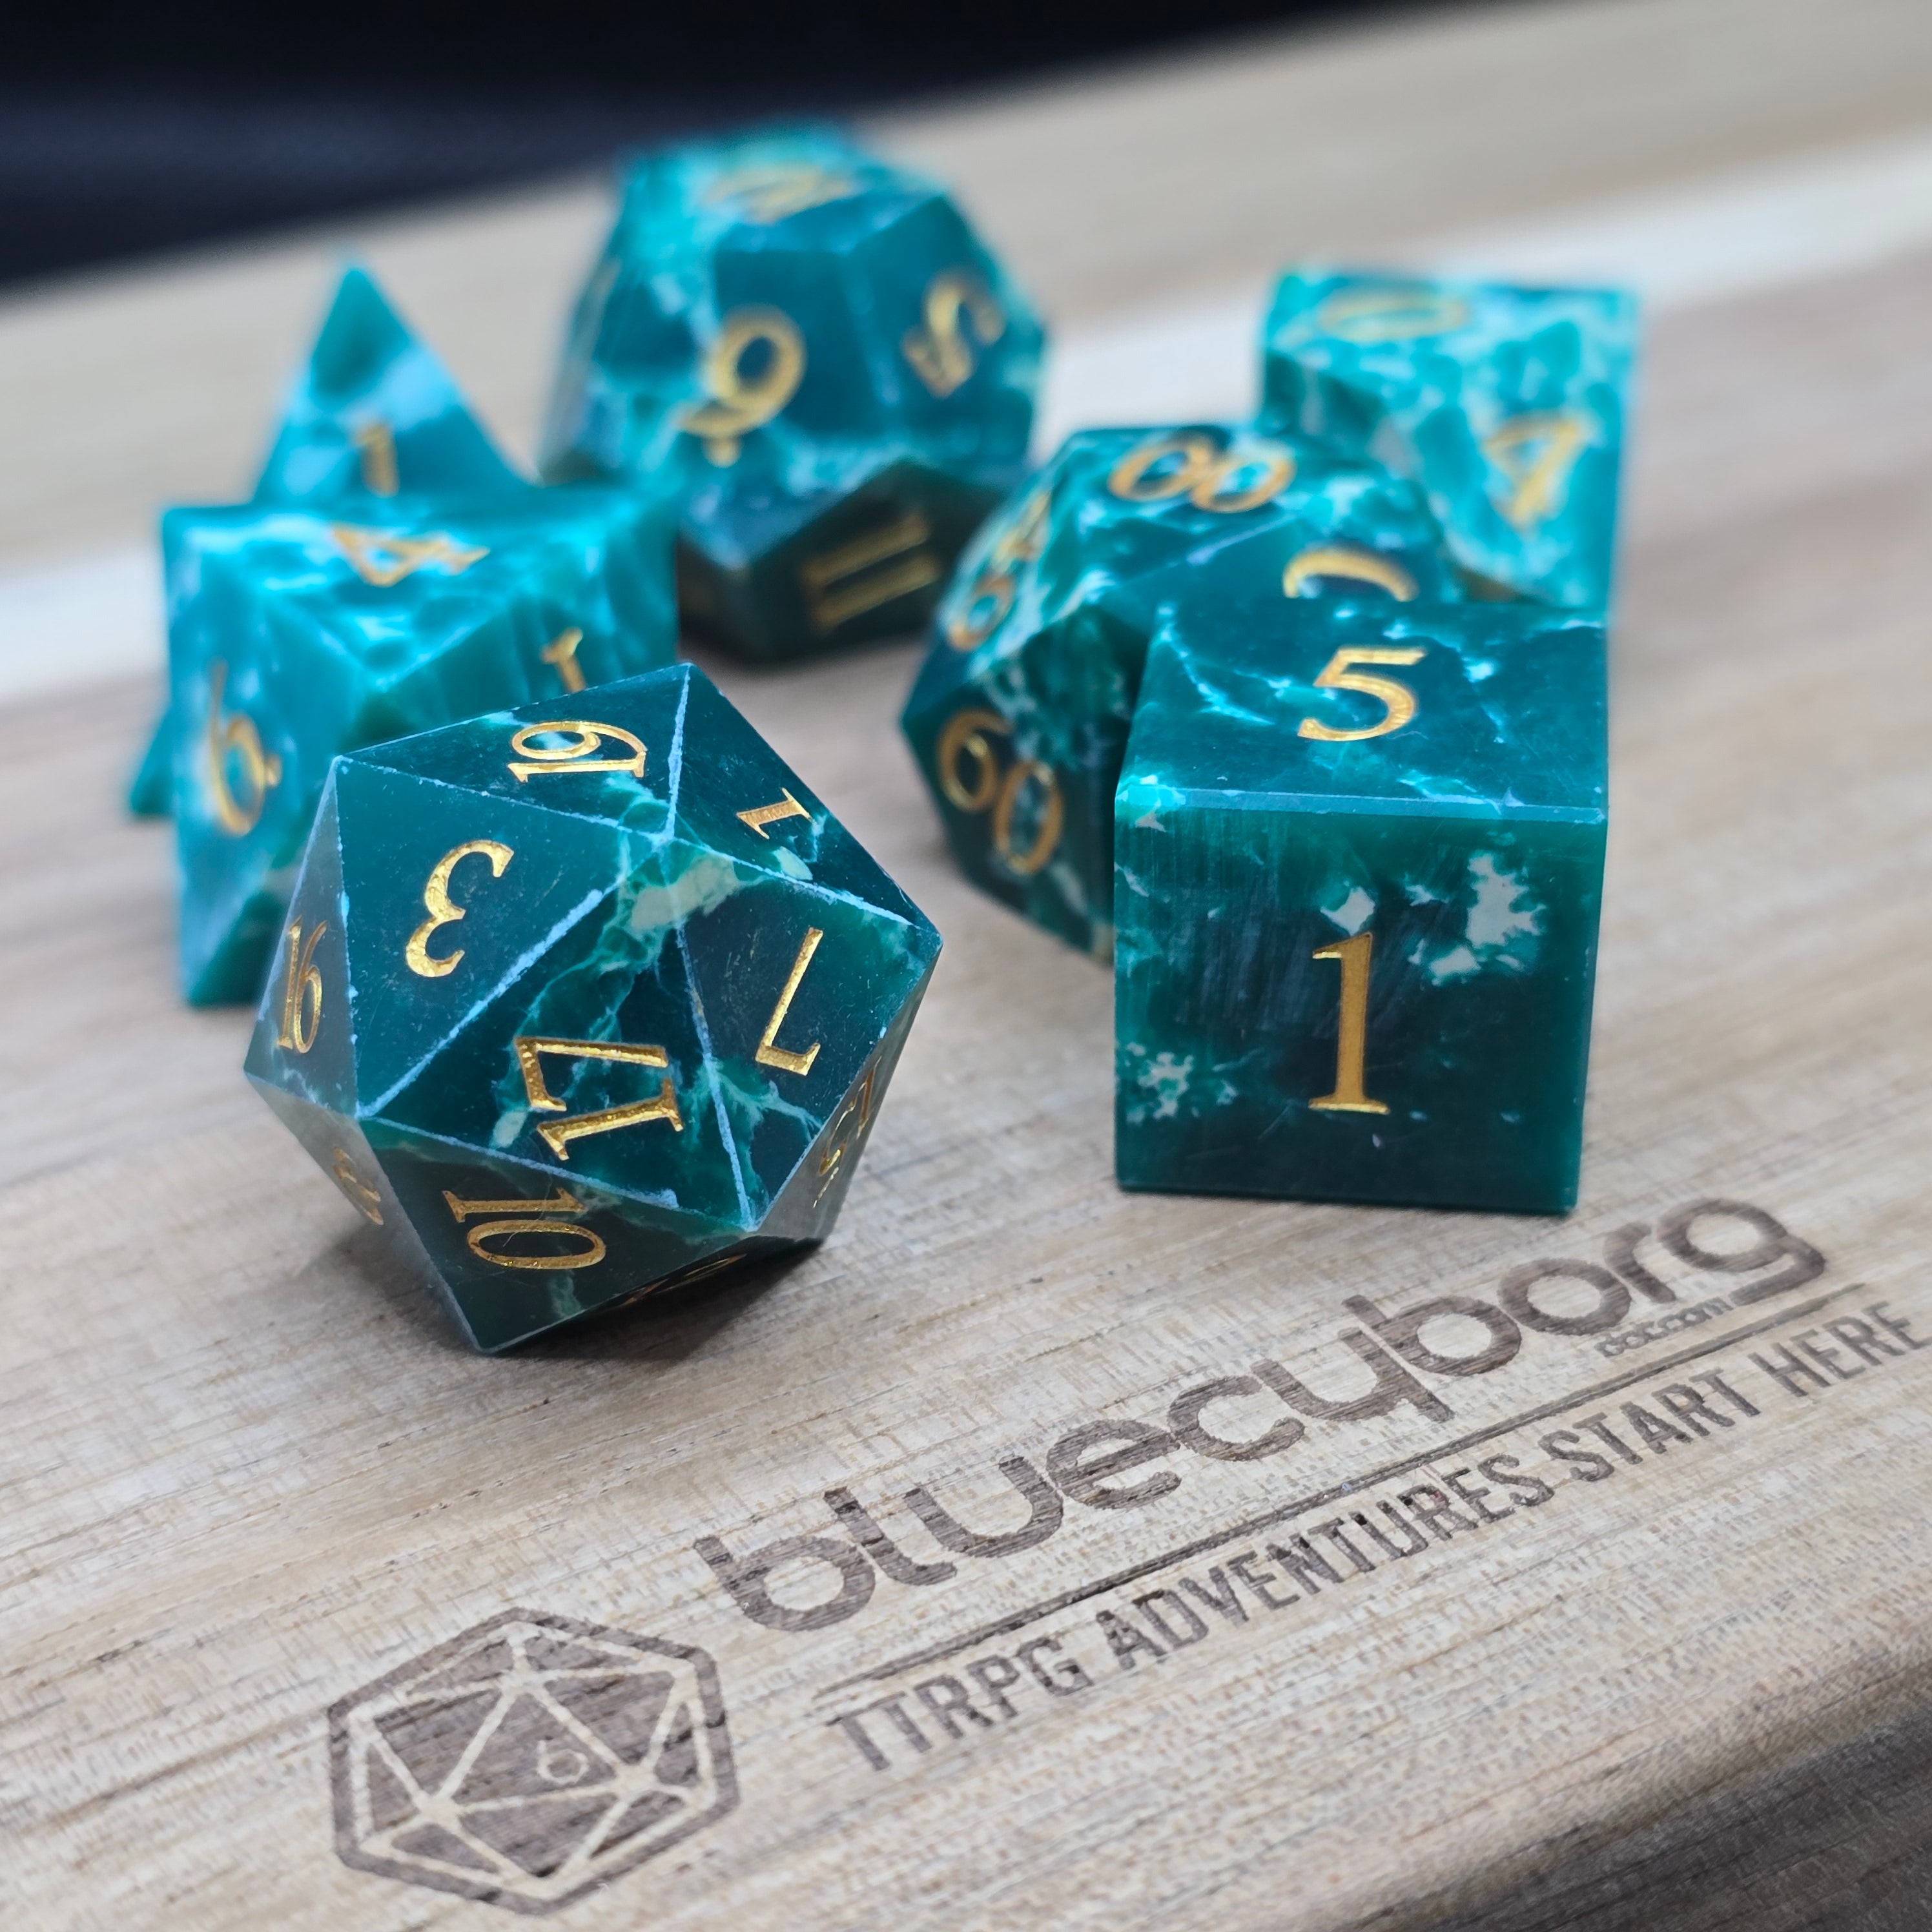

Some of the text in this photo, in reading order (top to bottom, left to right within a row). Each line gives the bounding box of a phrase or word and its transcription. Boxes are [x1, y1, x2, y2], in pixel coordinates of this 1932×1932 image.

[507, 719, 648, 783] 19
[1297, 648, 1426, 742] 5
[736, 787, 815, 839] 1
[938, 706, 1064, 877] 60
[406, 839, 515, 978] 3
[276, 914, 328, 1054] 16
[754, 926, 824, 1076] 7
[1308, 931, 1390, 1115] 1
[516, 1036, 684, 1161] 17
[442, 1187, 607, 1270] 10
[693, 1197, 1827, 1632] bluecyborg
[826, 1300, 1932, 1771] TTRPG ADVENTURES START HERE
